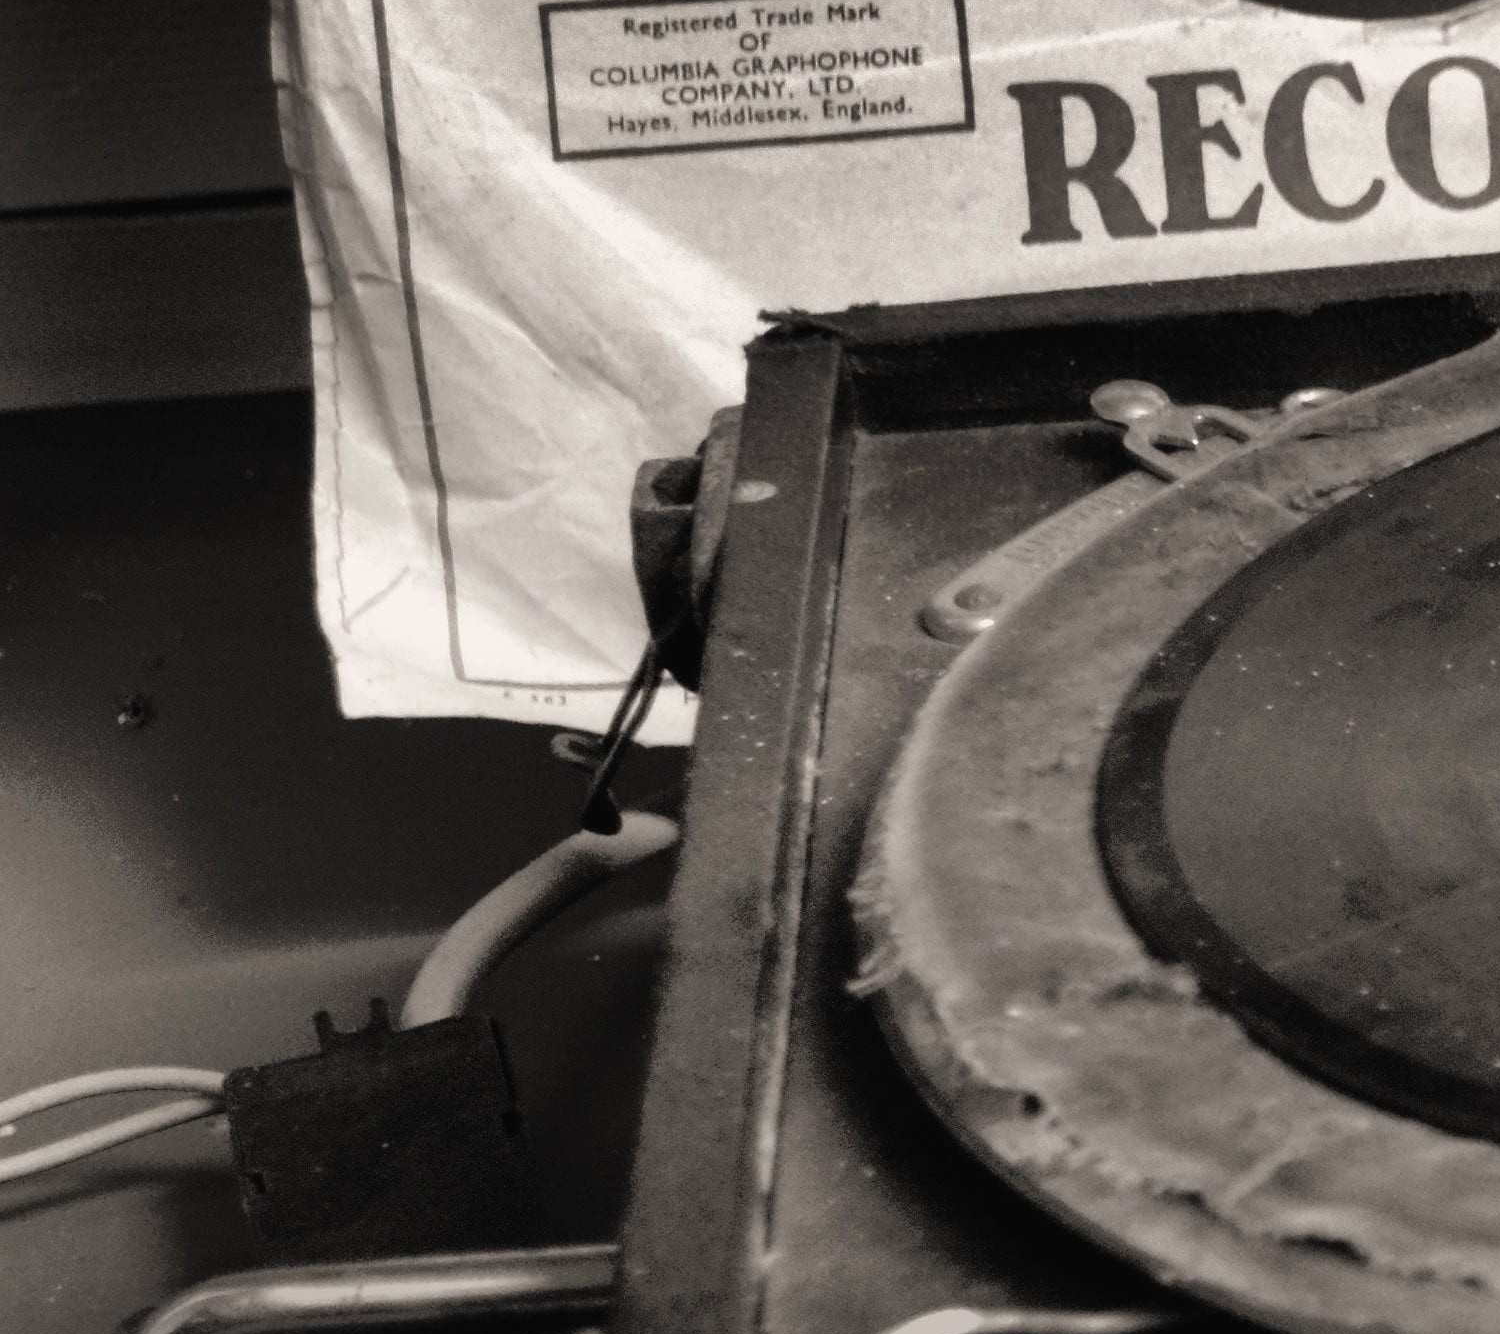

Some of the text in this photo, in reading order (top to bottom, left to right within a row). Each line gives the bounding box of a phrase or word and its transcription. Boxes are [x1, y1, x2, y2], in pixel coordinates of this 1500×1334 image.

[622, 1, 881, 36] Registered Trade Mark
[739, 31, 772, 53] OF
[590, 45, 925, 87] COLUMBIA GRAPHOPHONE
